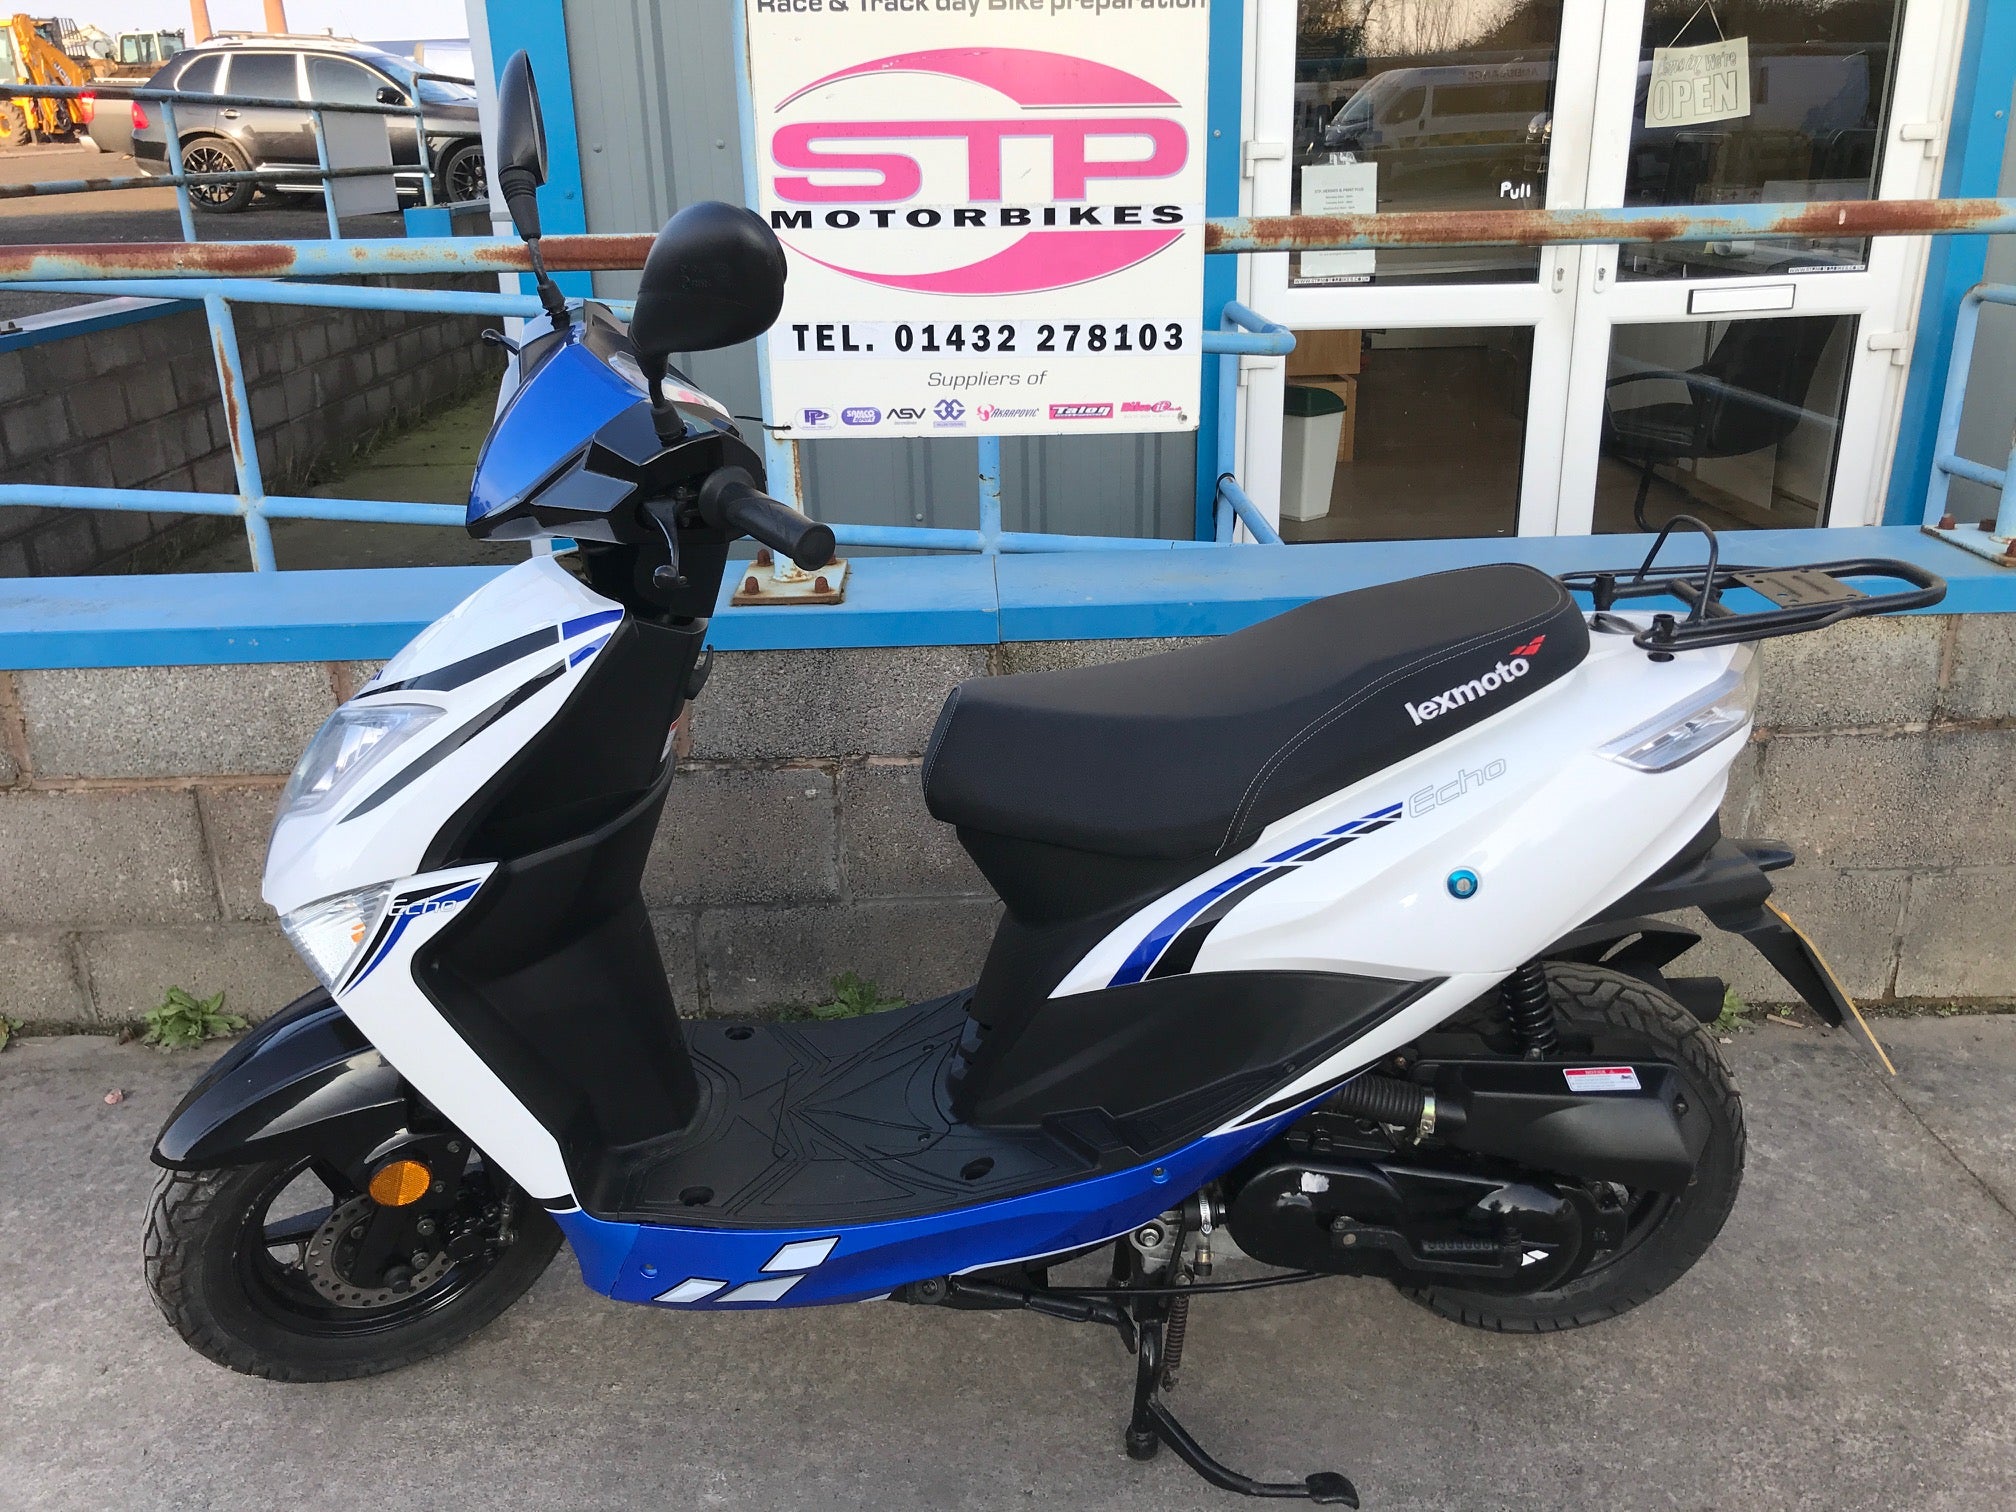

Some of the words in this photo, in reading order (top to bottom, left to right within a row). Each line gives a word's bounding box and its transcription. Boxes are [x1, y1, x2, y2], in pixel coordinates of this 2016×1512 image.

[757, 0, 823, 13] Race
[829, 0, 849, 12] &
[860, 0, 929, 12] Track
[935, 0, 980, 17] day
[988, 0, 1044, 10] Bike
[1050, 0, 1205, 16] preparation
[1653, 69, 1738, 121] OPEN
[770, 117, 1190, 205] STP
[1500, 181, 1531, 200] Pull
[770, 205, 1185, 230] MOTORBIKES
[792, 324, 874, 353] TEL.
[894, 323, 1017, 352] 01432
[1036, 322, 1184, 352] 278103
[927, 372, 1021, 391] Suppliers
[1026, 370, 1048, 387] of
[886, 407, 926, 420] ASV
[1051, 406, 1112, 416] Talon
[1404, 657, 1530, 727] lexmoto
[1408, 758, 1507, 819] Echo
[387, 897, 458, 917] Echo
